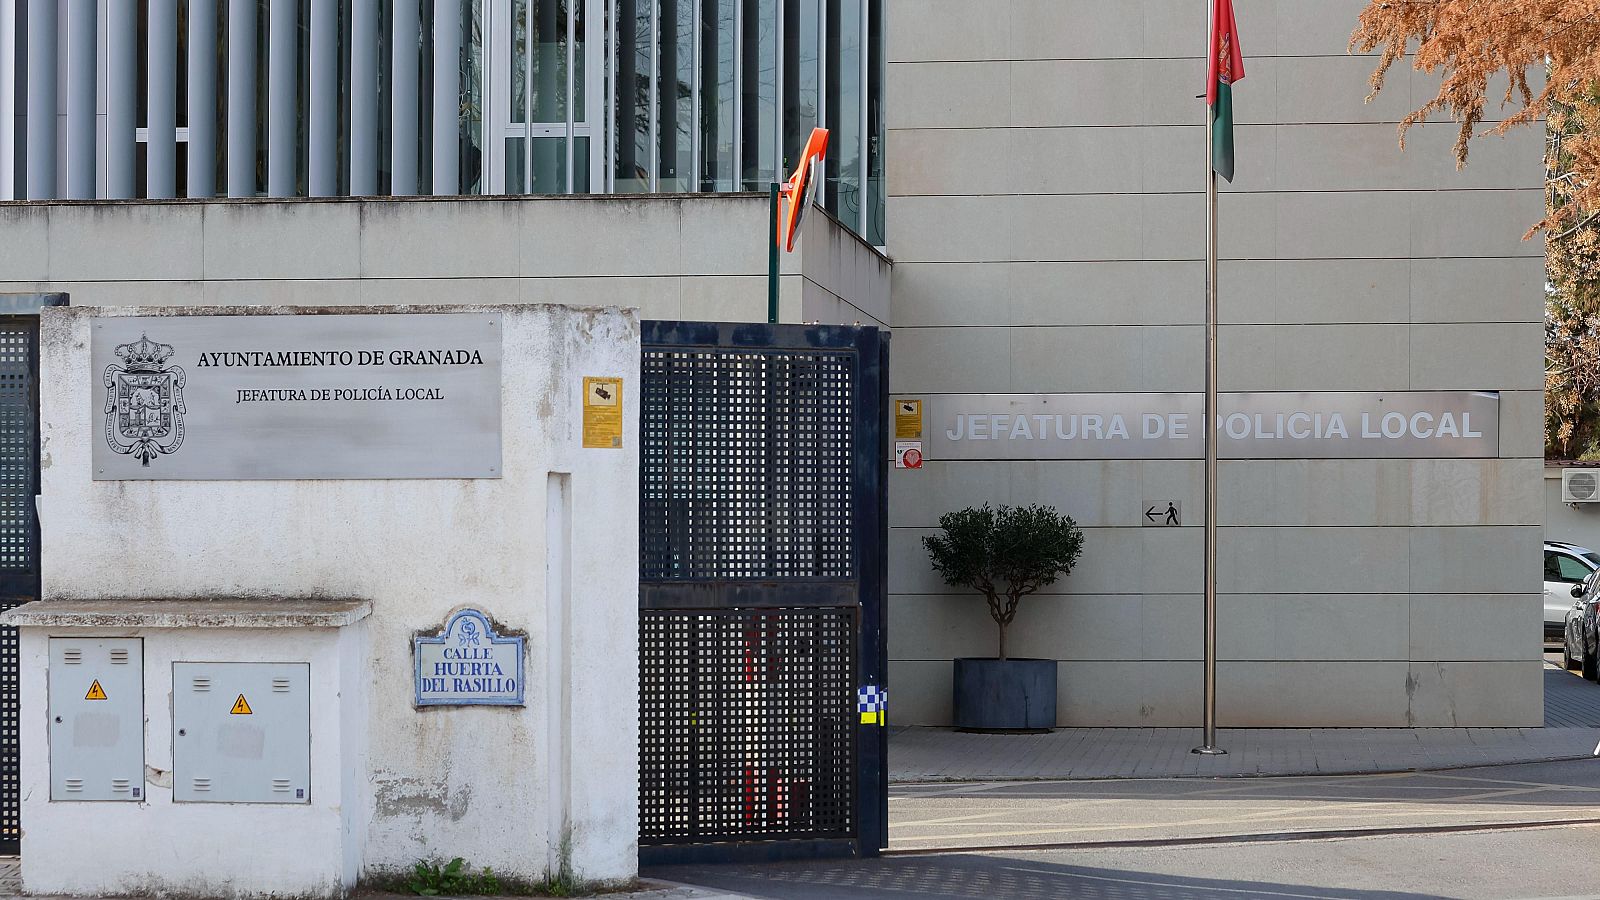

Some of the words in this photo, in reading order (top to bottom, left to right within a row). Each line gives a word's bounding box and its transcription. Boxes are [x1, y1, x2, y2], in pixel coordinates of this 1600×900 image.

[197, 350, 352, 367] AYUNTAMIENTO
[358, 351, 385, 366] DE
[389, 350, 484, 366] GRANADA
[236, 389, 307, 404] JEFATURA
[311, 389, 331, 401] DE
[334, 386, 393, 401] POLICÍA
[396, 389, 445, 401] LOCAL
[946, 412, 1130, 441] JEFATURA
[1142, 412, 1190, 440] DE
[1361, 411, 1483, 440] LOCAL
[443, 648, 493, 660] CALLE
[434, 662, 504, 676] HUERTA
[421, 678, 449, 693] DEL
[453, 678, 516, 693] RASILLO
